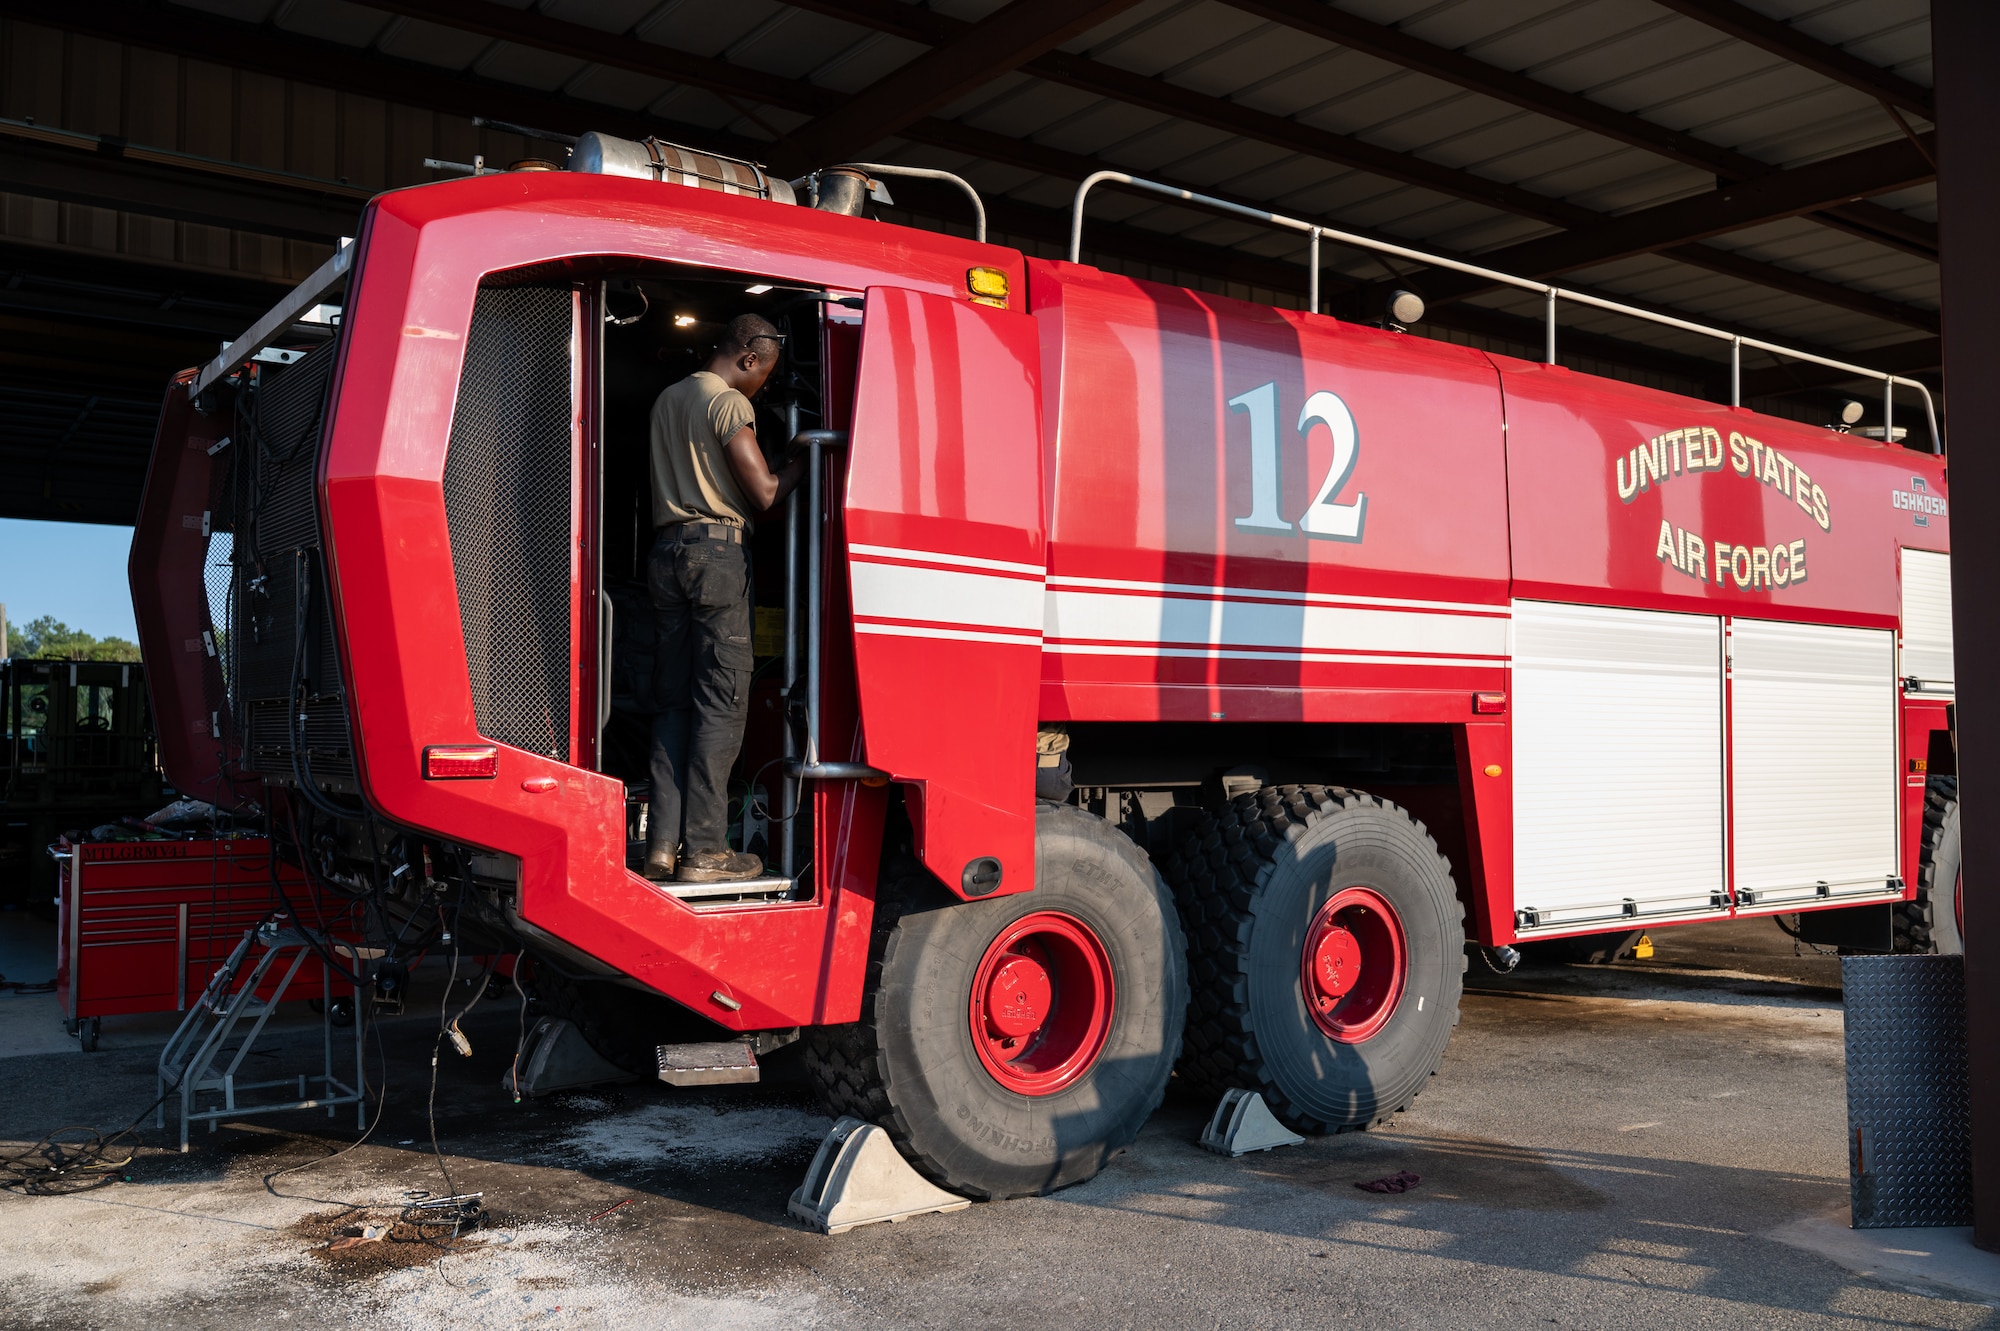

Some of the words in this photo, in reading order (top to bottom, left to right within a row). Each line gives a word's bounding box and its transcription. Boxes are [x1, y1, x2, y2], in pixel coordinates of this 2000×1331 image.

[1227, 379, 1369, 545] 12
[1616, 426, 1724, 503] UNITED
[1729, 431, 1831, 533] STATES
[1892, 489, 1947, 517] OSHKOSH
[1656, 519, 1709, 583] AIR
[1714, 538, 1808, 592] FORCE
